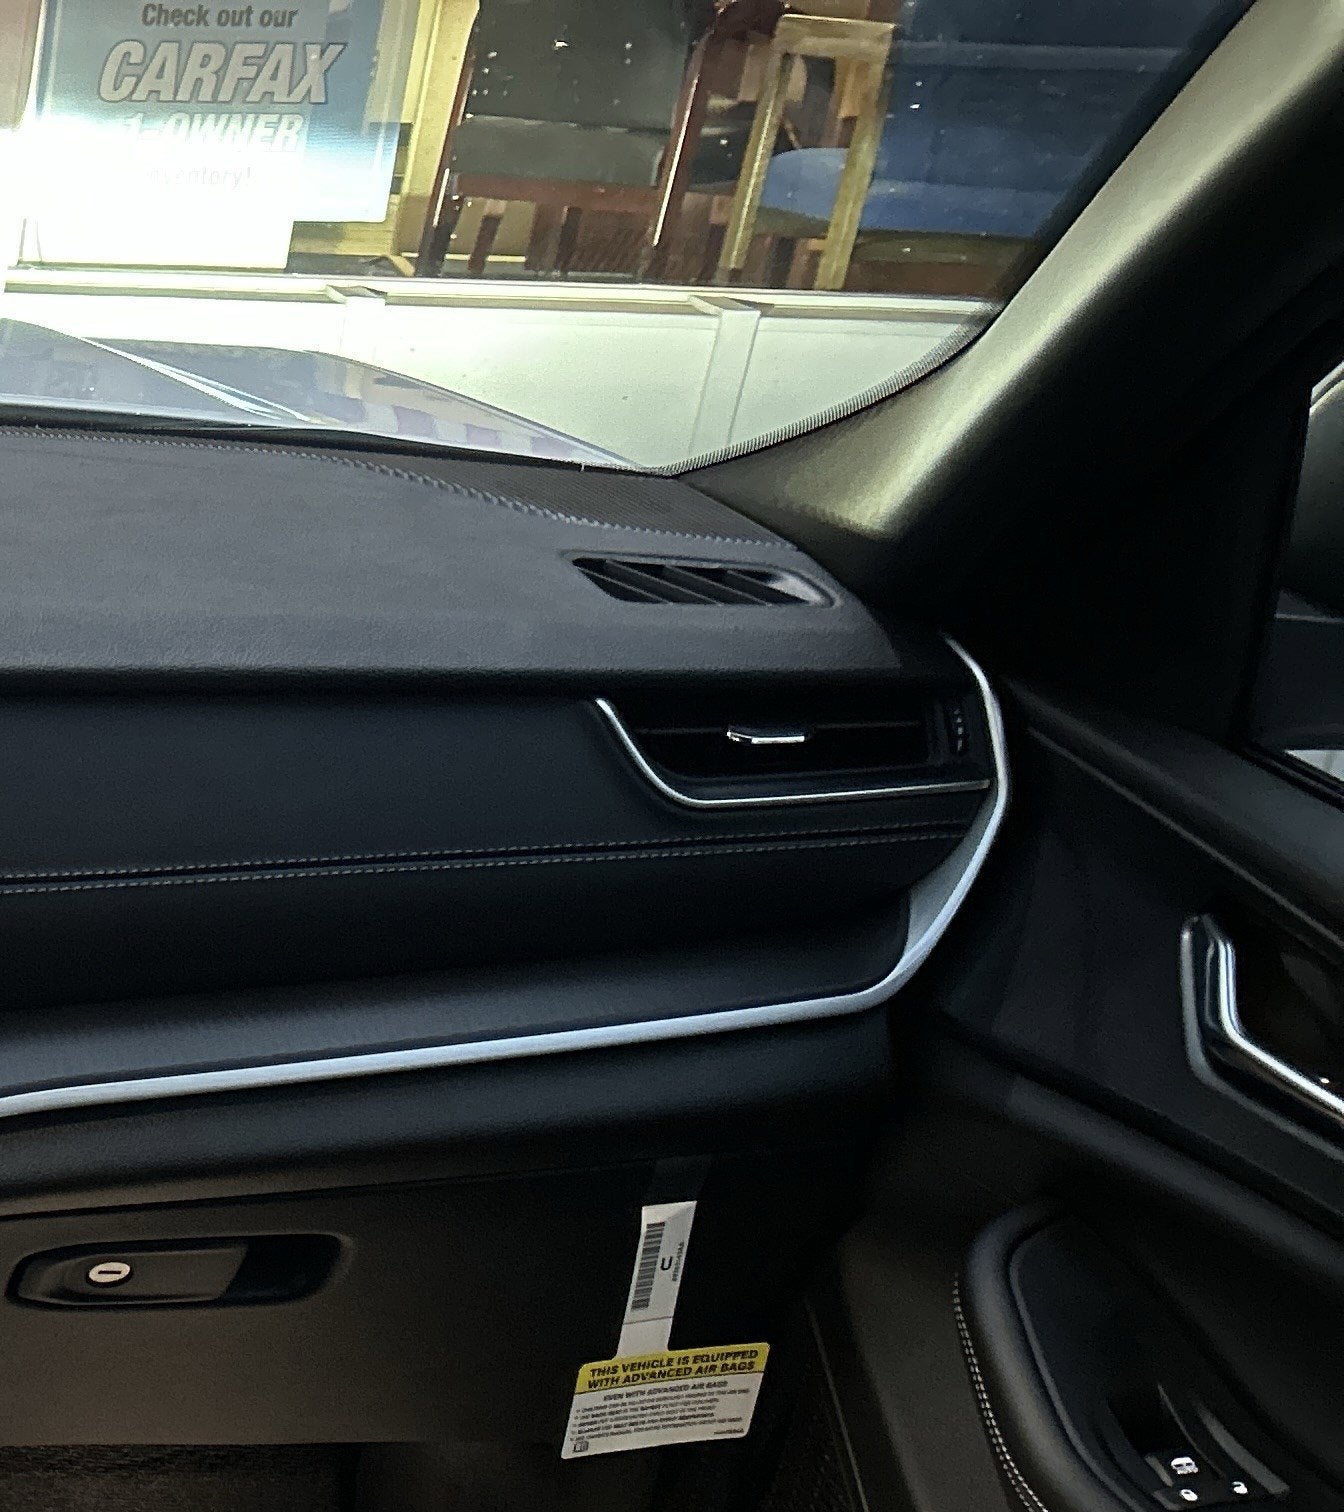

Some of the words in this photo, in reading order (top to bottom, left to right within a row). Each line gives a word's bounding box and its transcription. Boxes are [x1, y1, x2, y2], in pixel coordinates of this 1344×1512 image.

[141, 3, 210, 28] Check
[217, 7, 254, 28] out
[260, 7, 299, 28] our
[98, 39, 347, 104] CARFAX
[588, 1376, 620, 1389] WITH
[622, 1368, 692, 1384] ADVANCED
[696, 1364, 717, 1374] AIR
[720, 1360, 755, 1372] BAGS
[590, 1366, 619, 1379] THIS
[621, 1357, 674, 1374] VEHICLE
[677, 1355, 690, 1366] IS
[693, 1349, 759, 1364] EQUIPPED
